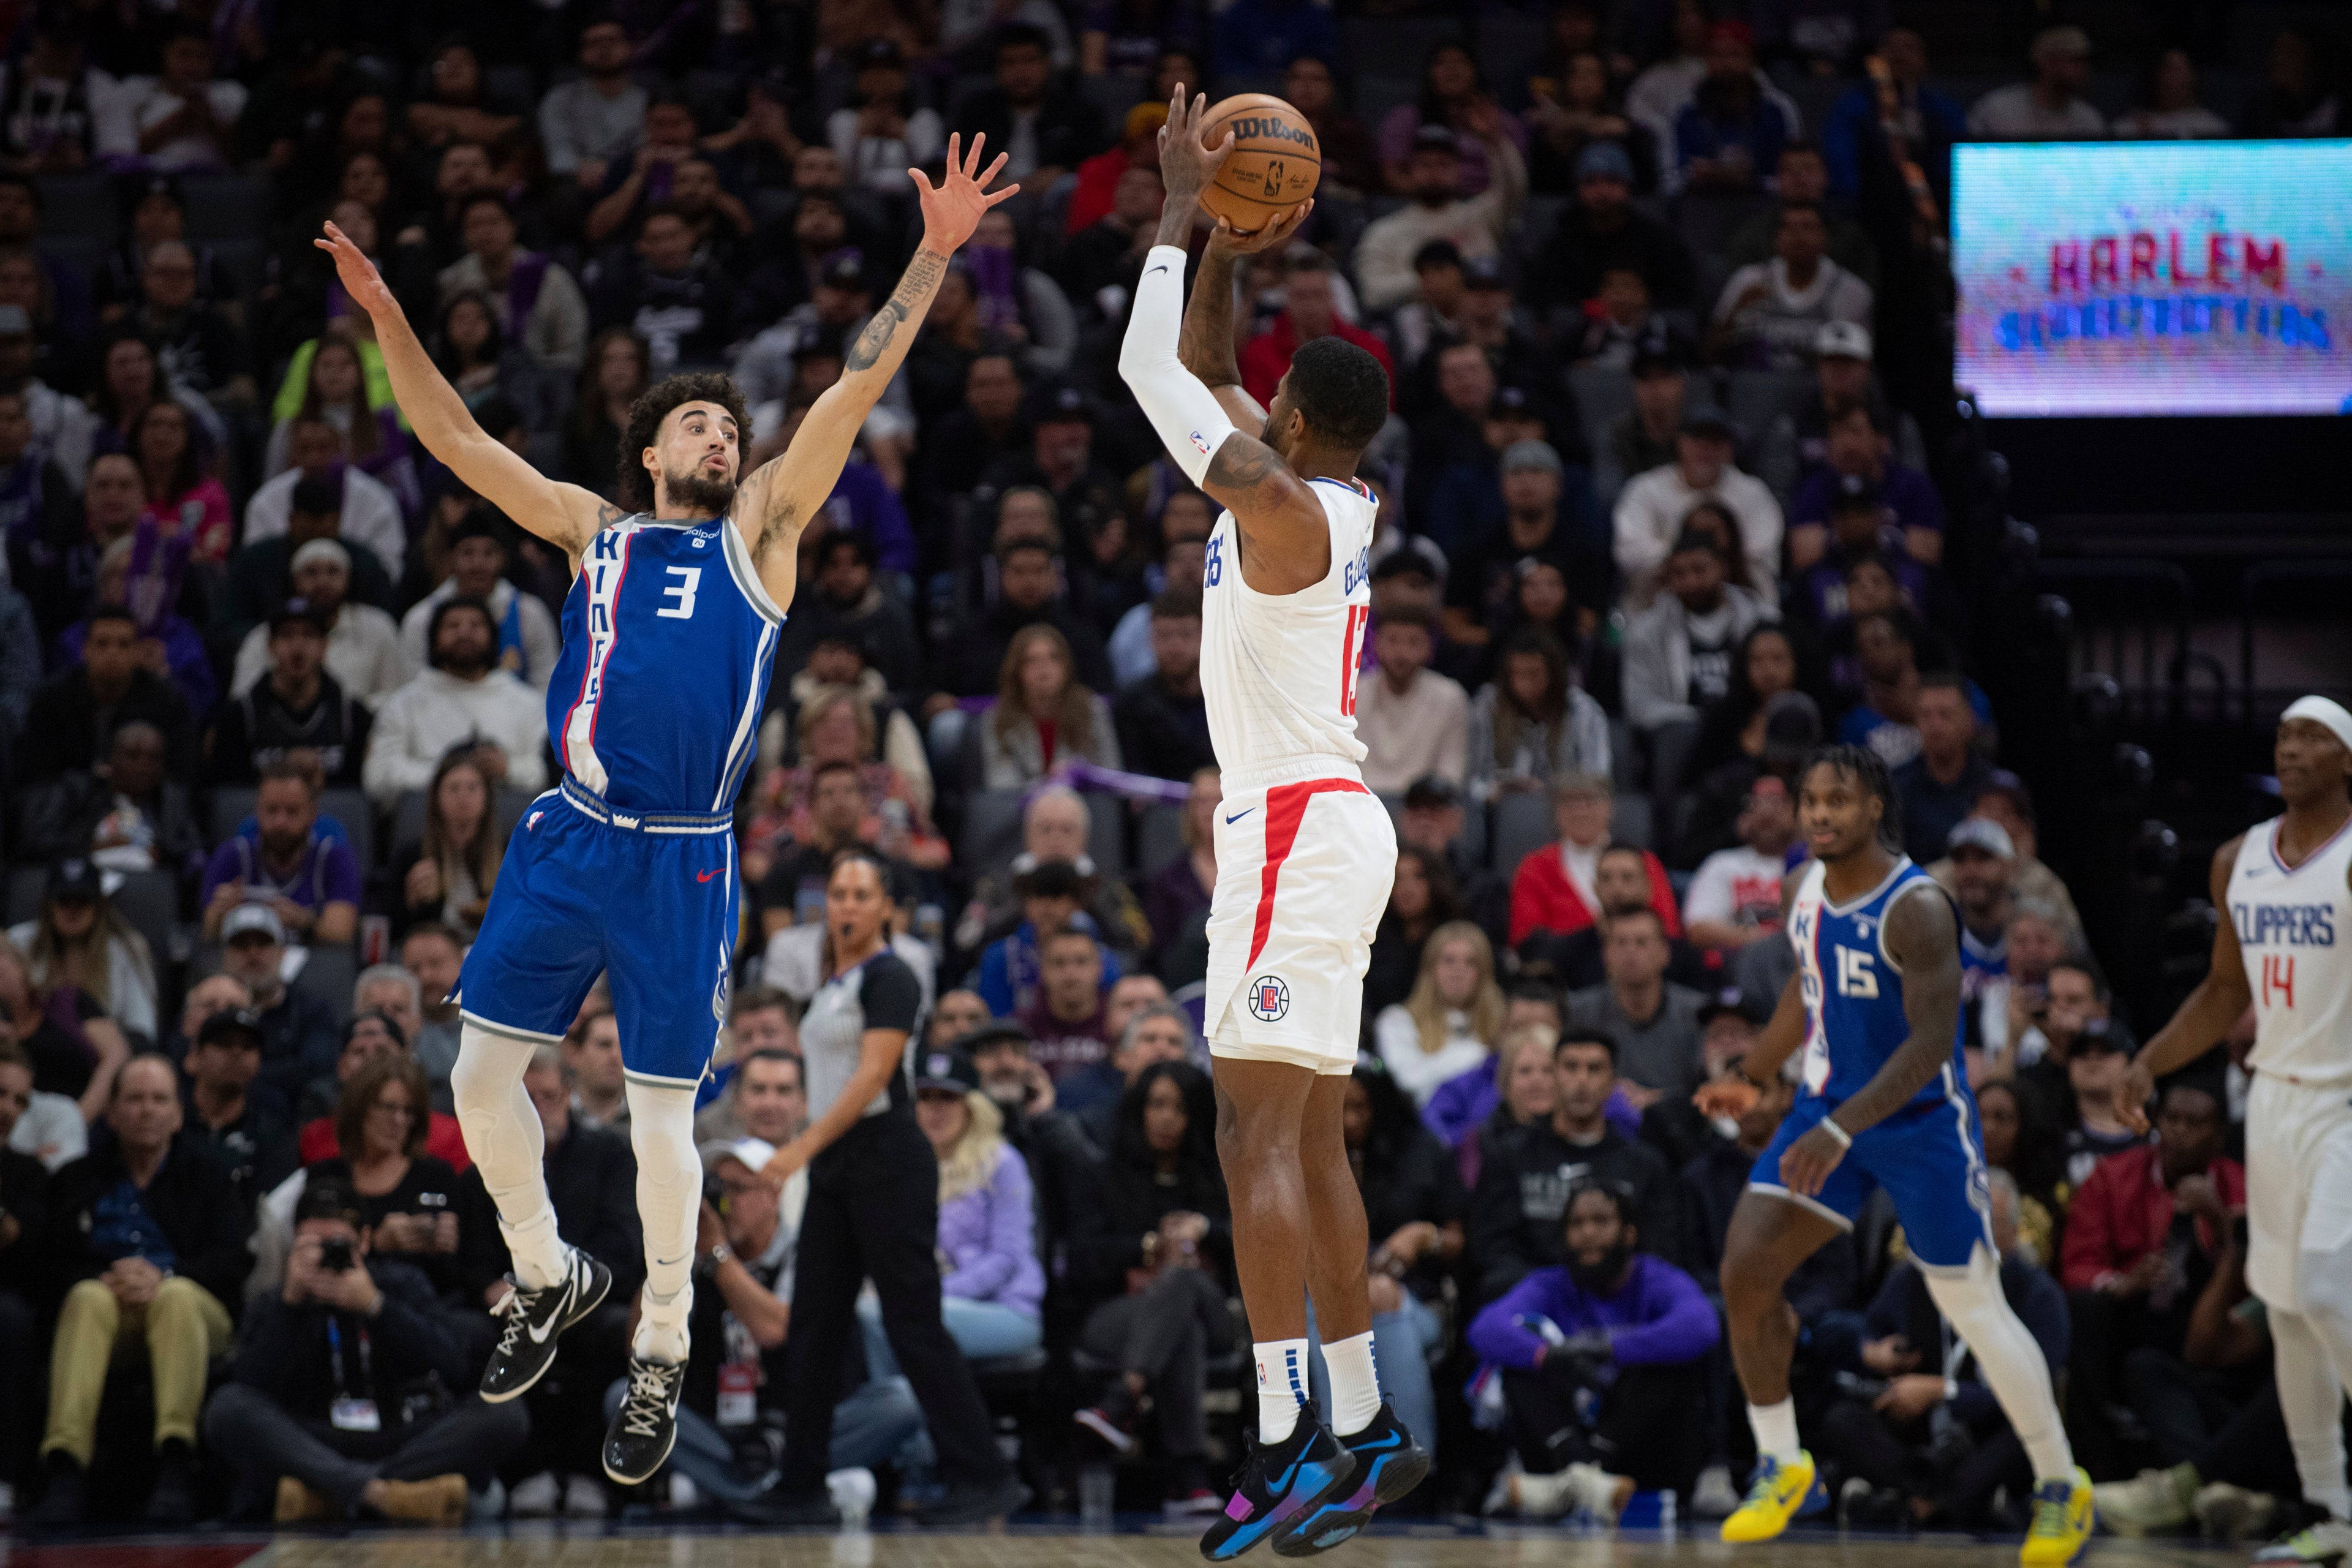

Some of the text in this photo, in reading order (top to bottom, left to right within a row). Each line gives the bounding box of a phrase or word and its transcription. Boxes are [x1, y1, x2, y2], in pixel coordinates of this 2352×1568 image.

[1231, 117, 1314, 151] Wilson
[2049, 229, 2288, 295] HARLEM
[657, 565, 702, 619] 3
[2234, 902, 2334, 946] CLIPPERS
[1834, 943, 1879, 1000] 15
[2262, 954, 2294, 1009] 14
